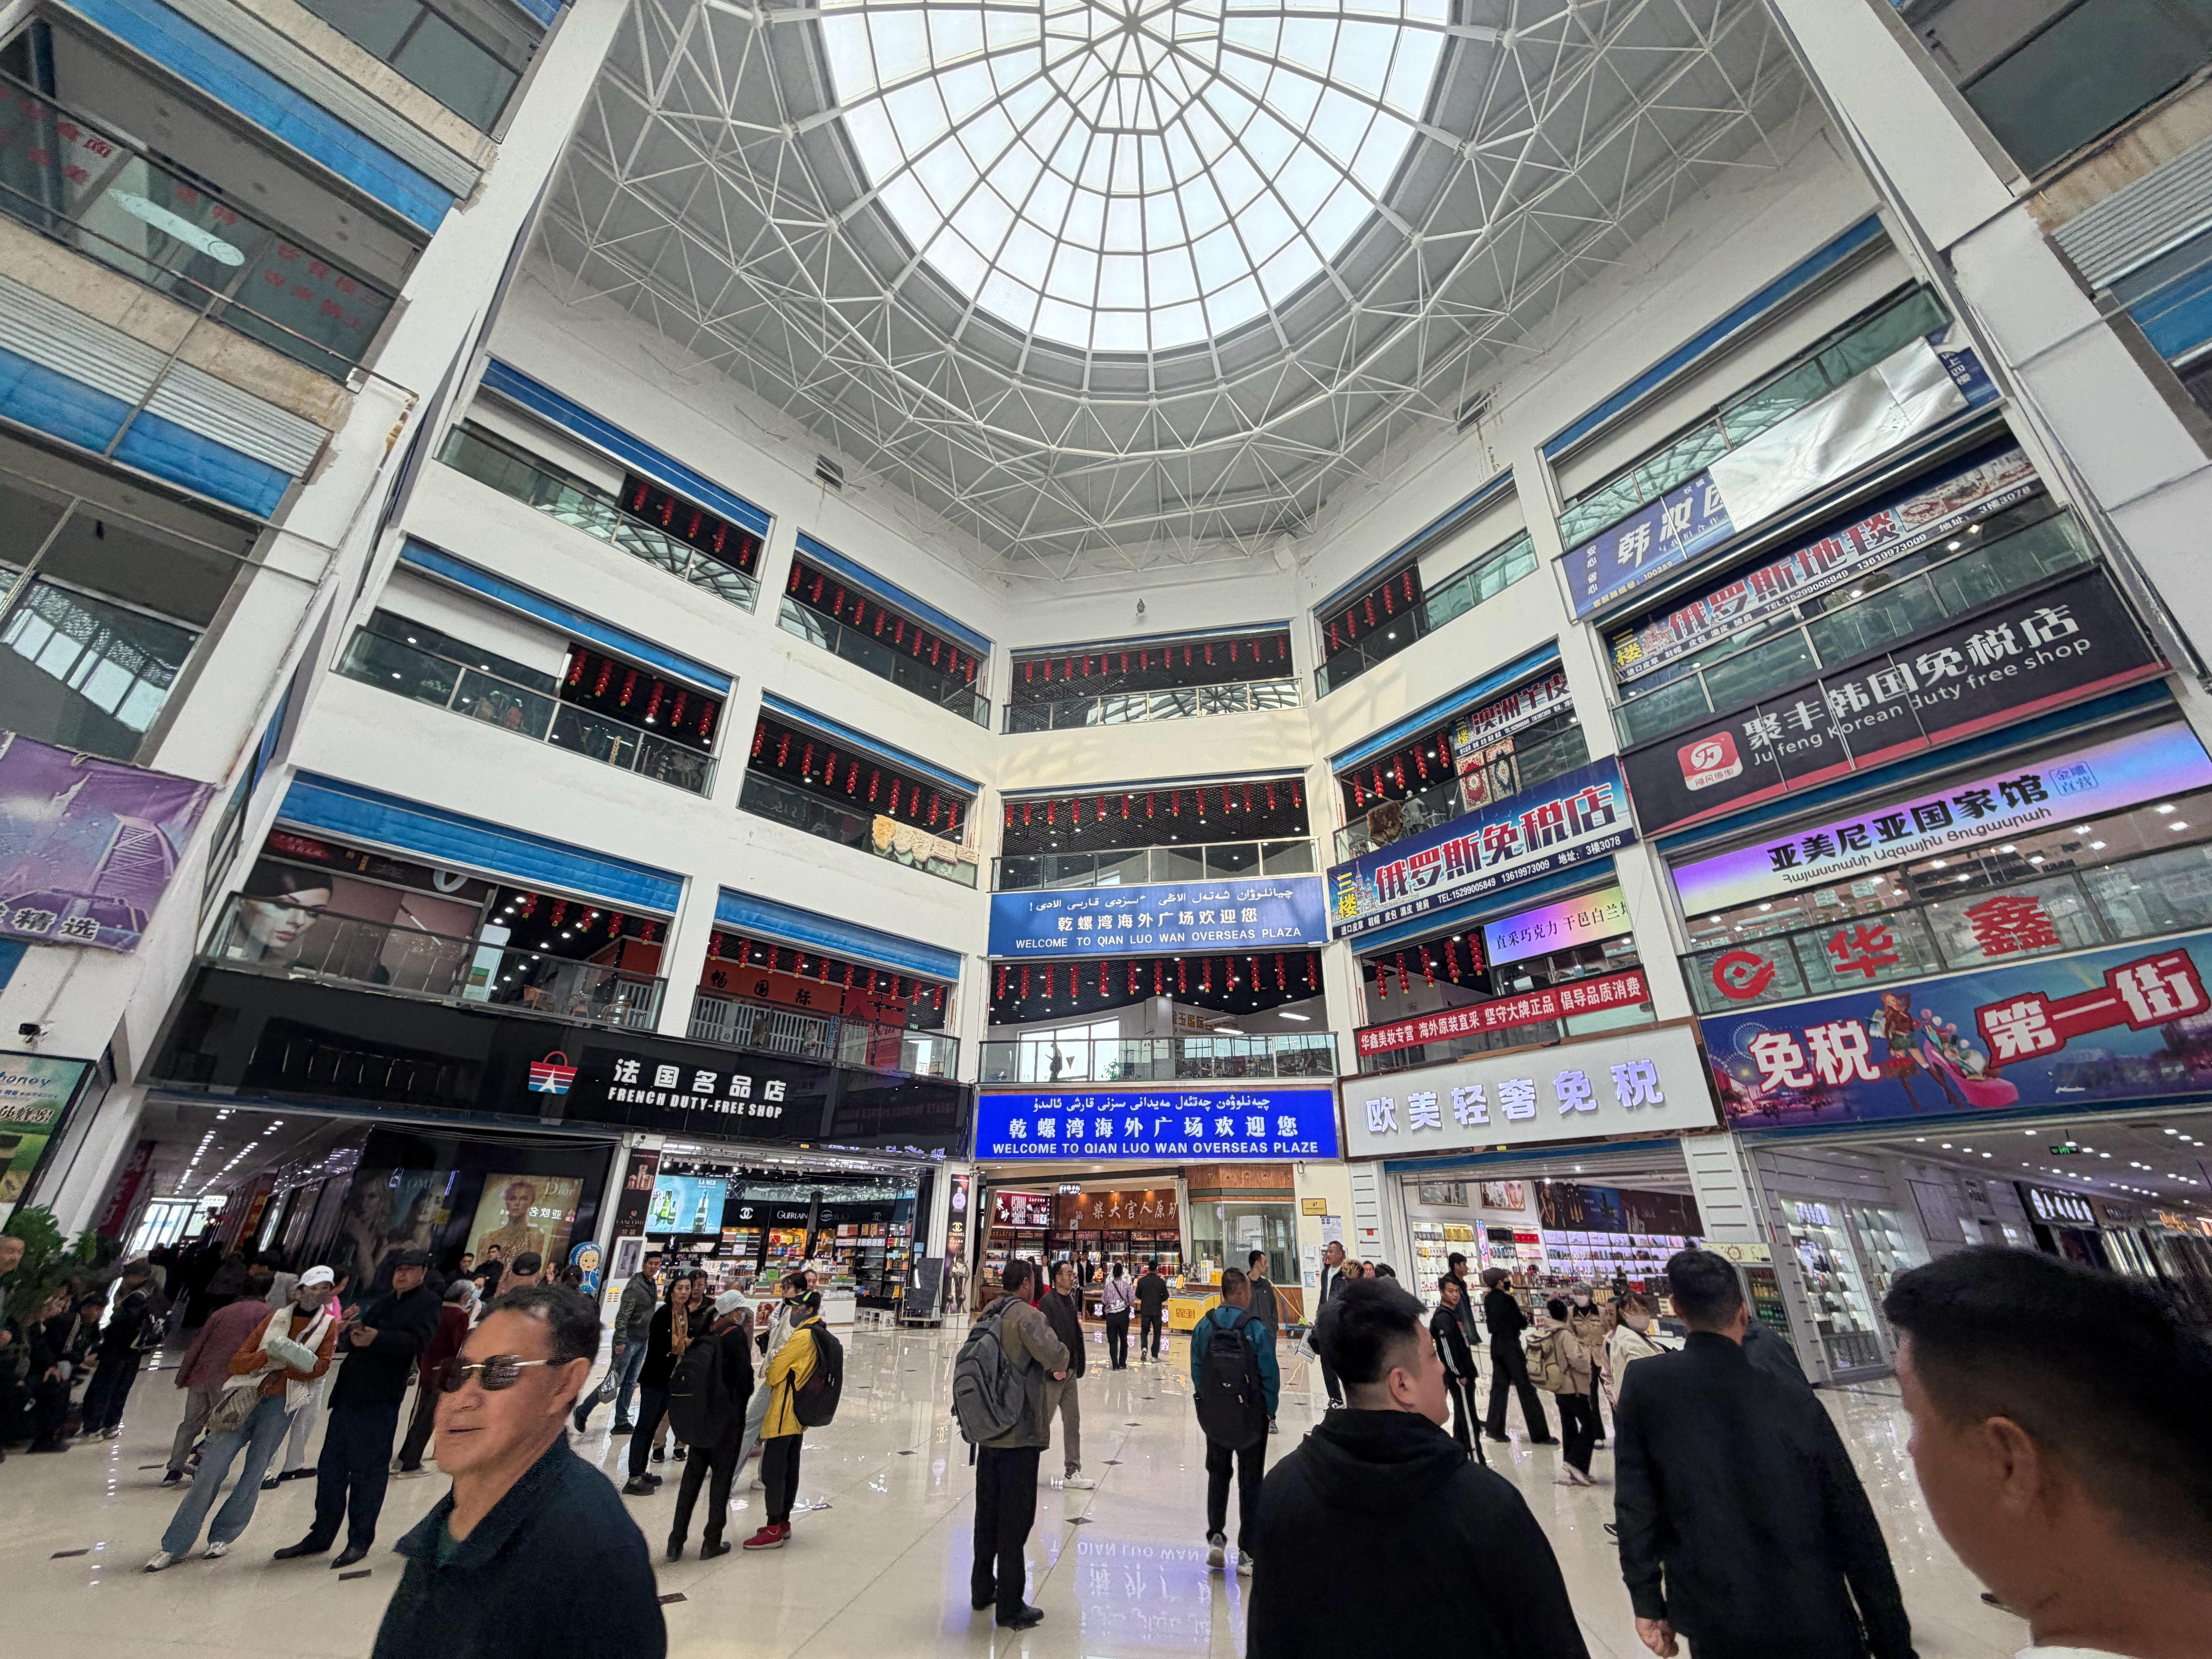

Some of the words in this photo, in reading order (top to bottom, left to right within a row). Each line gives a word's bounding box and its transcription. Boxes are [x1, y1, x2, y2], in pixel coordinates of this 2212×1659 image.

[1668, 510, 1900, 644] 俄罗斯地毯
[1613, 629, 1643, 666] 三楼
[1742, 605, 2080, 750] 聚丰韩国免税店
[1754, 749, 1774, 766] Ju
[1777, 732, 1822, 758] feng
[1828, 704, 1904, 740] Korean
[1911, 684, 1961, 711] duty
[1966, 665, 2018, 690] free
[2027, 637, 2091, 670] shop
[1456, 716, 1469, 745] 三楼
[1374, 782, 1618, 905] 俄罗斯免税店
[1767, 775, 2049, 873] 亚美尼亚国家馆
[1192, 890, 1230, 903] شەتەل
[1337, 872, 1358, 919] 三楼
[1341, 920, 1364, 936] 进口皮草
[1368, 915, 1381, 927] 鞋帽
[1385, 910, 1397, 922] 皮包
[1437, 878, 1496, 904] TEL:15299005849
[1501, 859, 1550, 883] 13619973009
[1586, 836, 1621, 855] 3楼3078
[1016, 937, 1068, 948] WELCOME
[1077, 936, 1091, 946] TO
[1097, 934, 1124, 946] QIAN
[1130, 933, 1153, 944] LUO
[1159, 932, 1185, 943] WAN
[1192, 929, 1255, 941] OVERSEAS
[1262, 927, 1302, 938] PLAZA
[1058, 908, 1258, 932] 乾螺湾海外广场欢迎您
[1496, 921, 1558, 950] 直采巧克力
[1827, 895, 2061, 977] 华鑫
[1361, 1025, 1414, 1050] 华鑫美妆专营
[1419, 1009, 1480, 1038] 海外原装直采
[1485, 994, 1554, 1025] 坚守大牌正品
[1561, 977, 1641, 1010] 倡导品质消费
[1749, 1018, 1881, 1094] 免税
[1985, 958, 2200, 1059] 第一街
[613, 1058, 787, 1102] 法国名品店
[1366, 1059, 1664, 1132] 欧美轻奢免税
[608, 1087, 665, 1106] FRENCH
[671, 1094, 745, 1115] DUTY-FREE
[748, 1103, 783, 1119] SHOP
[1066, 1097, 1094, 1112] قارشى
[1009, 1115, 1298, 1139] 乾螺湾海外广场欢迎您
[993, 1143, 1057, 1154] WELCOME
[1062, 1142, 1079, 1154] TO
[1084, 1142, 1118, 1154] QIAN
[1123, 1142, 1149, 1154] LUO
[1152, 1142, 1188, 1154] WAN
[1193, 1142, 1268, 1154] OVERSEAS
[1274, 1142, 1319, 1153] PLAZE
[544, 1181, 575, 1195] Dior
[777, 1210, 808, 1219] GUERLAIN
